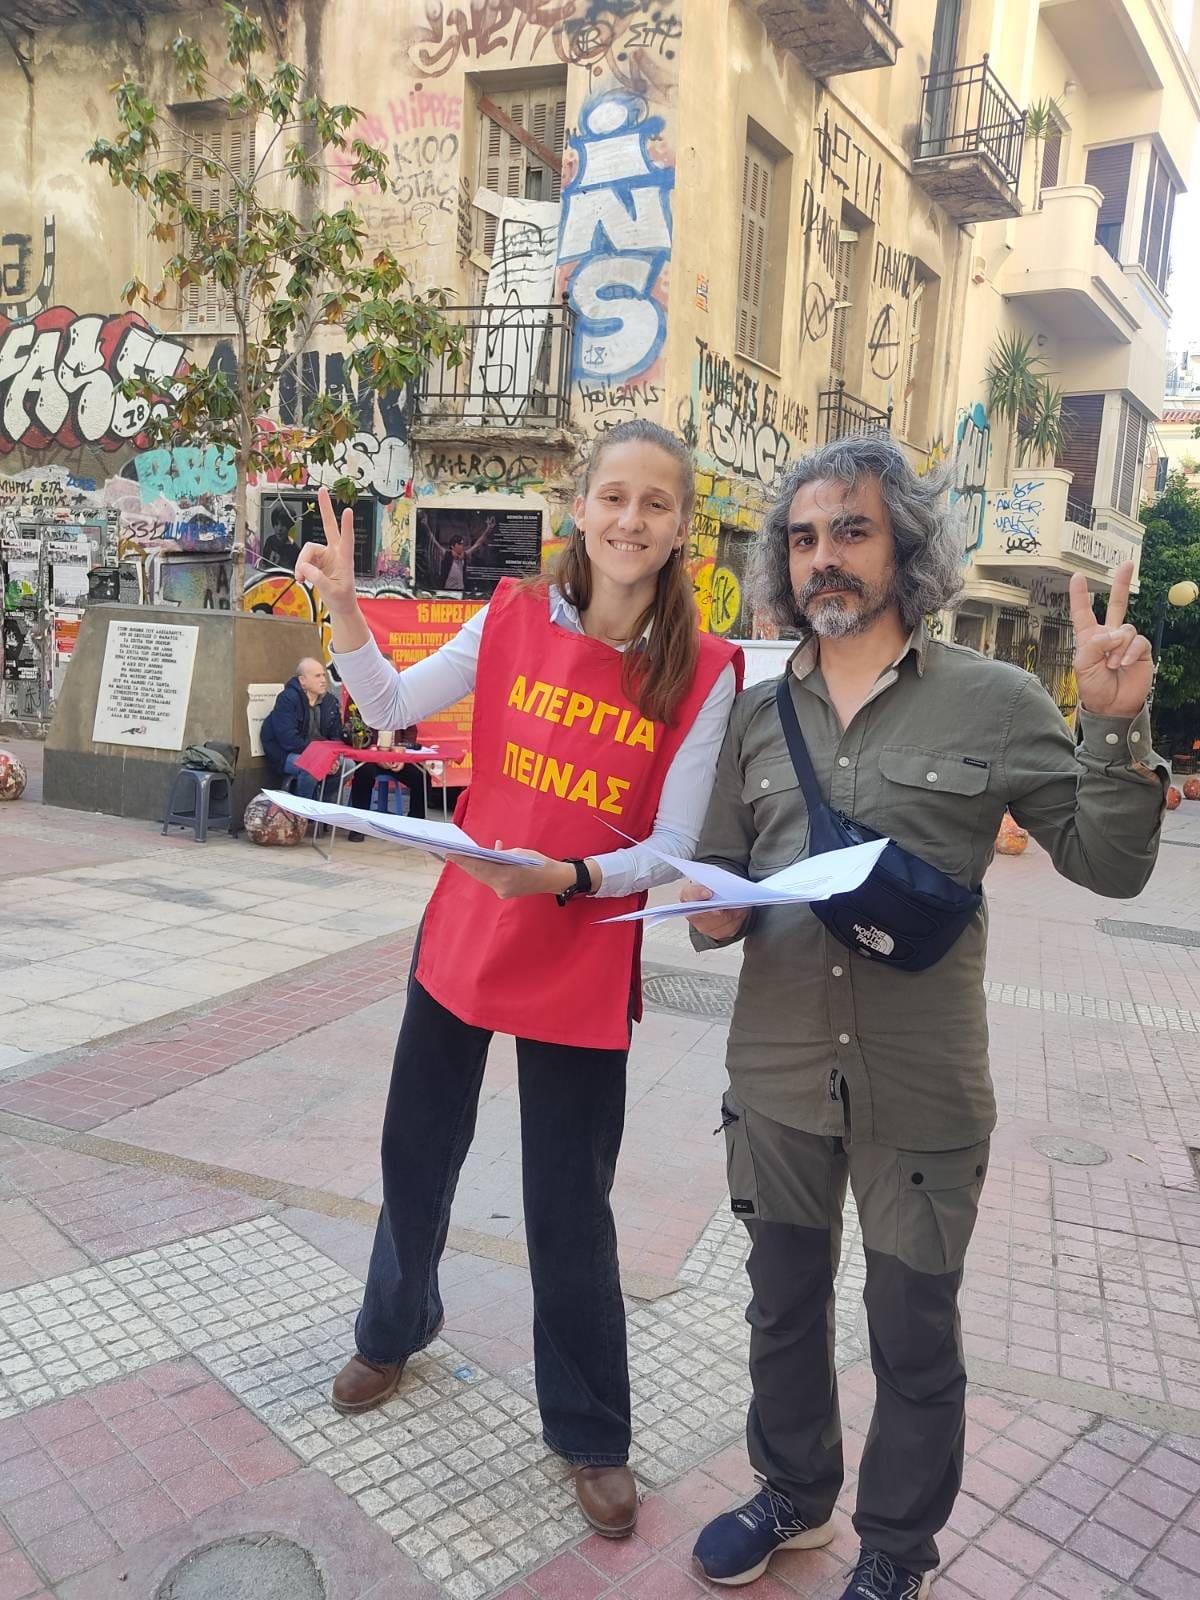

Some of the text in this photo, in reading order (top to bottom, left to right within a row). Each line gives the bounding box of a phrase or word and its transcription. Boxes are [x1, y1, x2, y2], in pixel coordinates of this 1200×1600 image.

[416, 603, 430, 623] 15
[431, 603, 464, 623] ΜΕΡΕΣ
[508, 674, 655, 753] ΑΠΕΡΓΙΑ
[502, 741, 631, 816] ΠΕΙΝΑΣ
[852, 924, 883, 945] NORTH
[870, 925, 886, 938] THE
[856, 933, 881, 951] FACE
